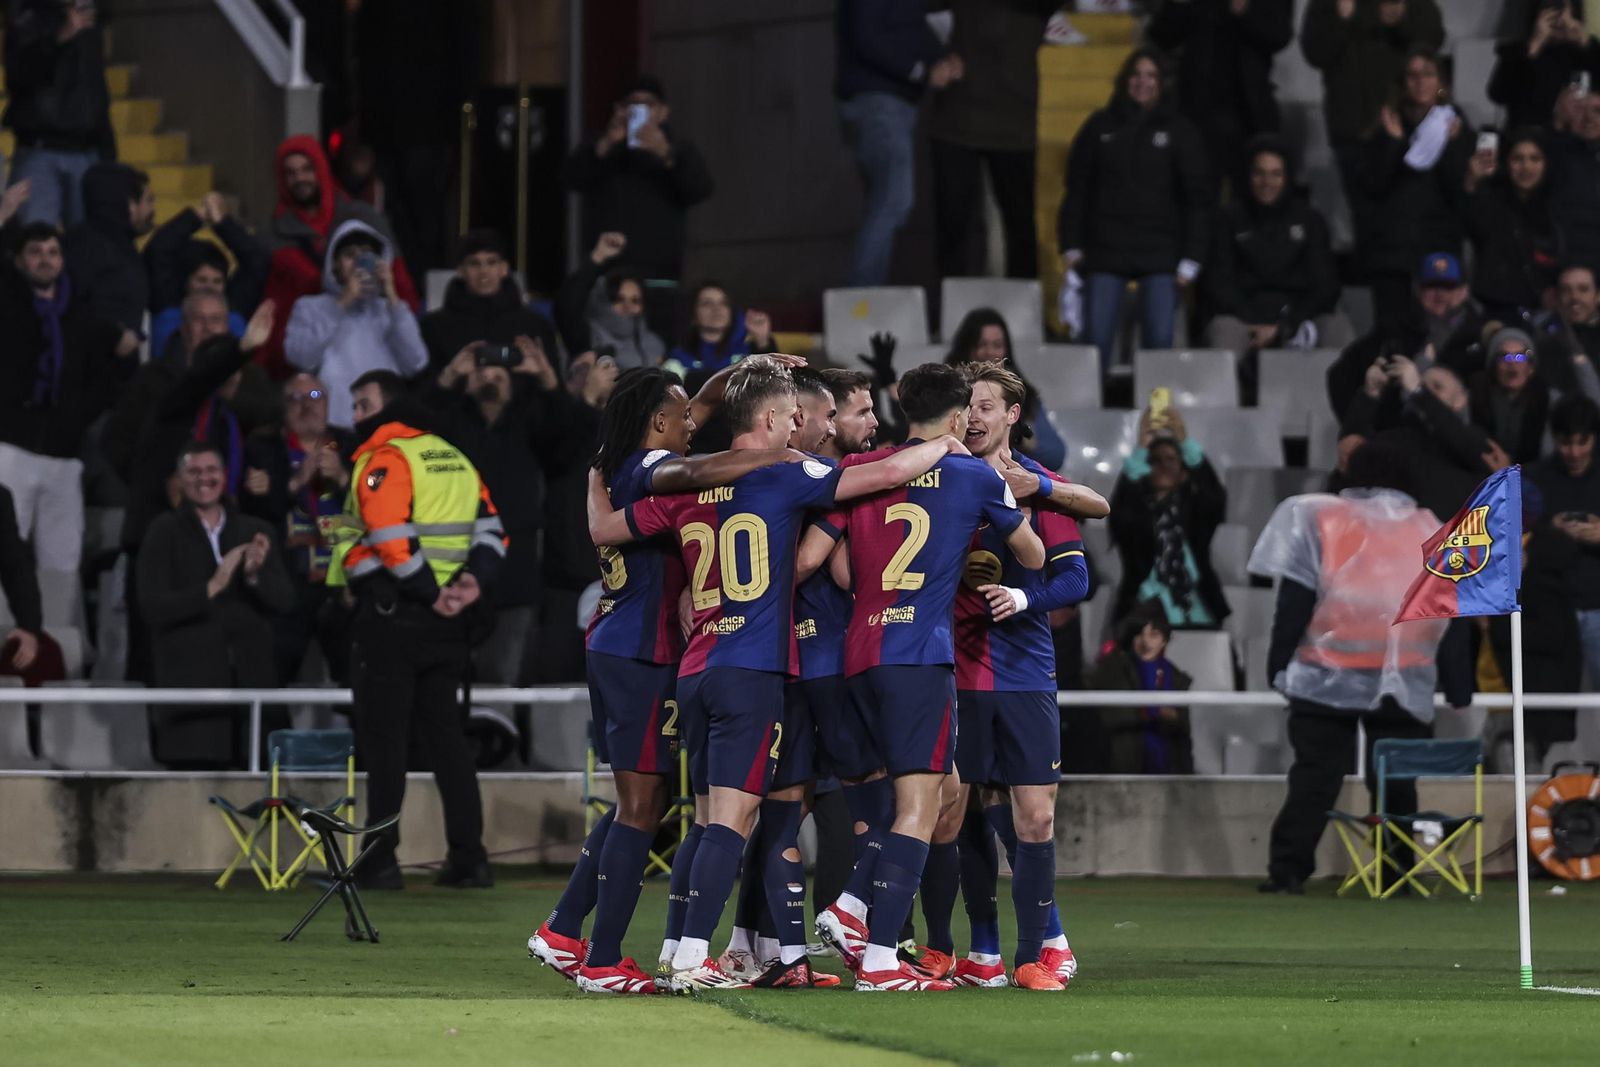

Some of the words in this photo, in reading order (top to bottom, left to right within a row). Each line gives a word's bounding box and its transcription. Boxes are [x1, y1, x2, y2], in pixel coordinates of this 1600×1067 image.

[680, 512, 770, 611] 20
[882, 503, 930, 591] 2
[661, 699, 678, 736] 2
